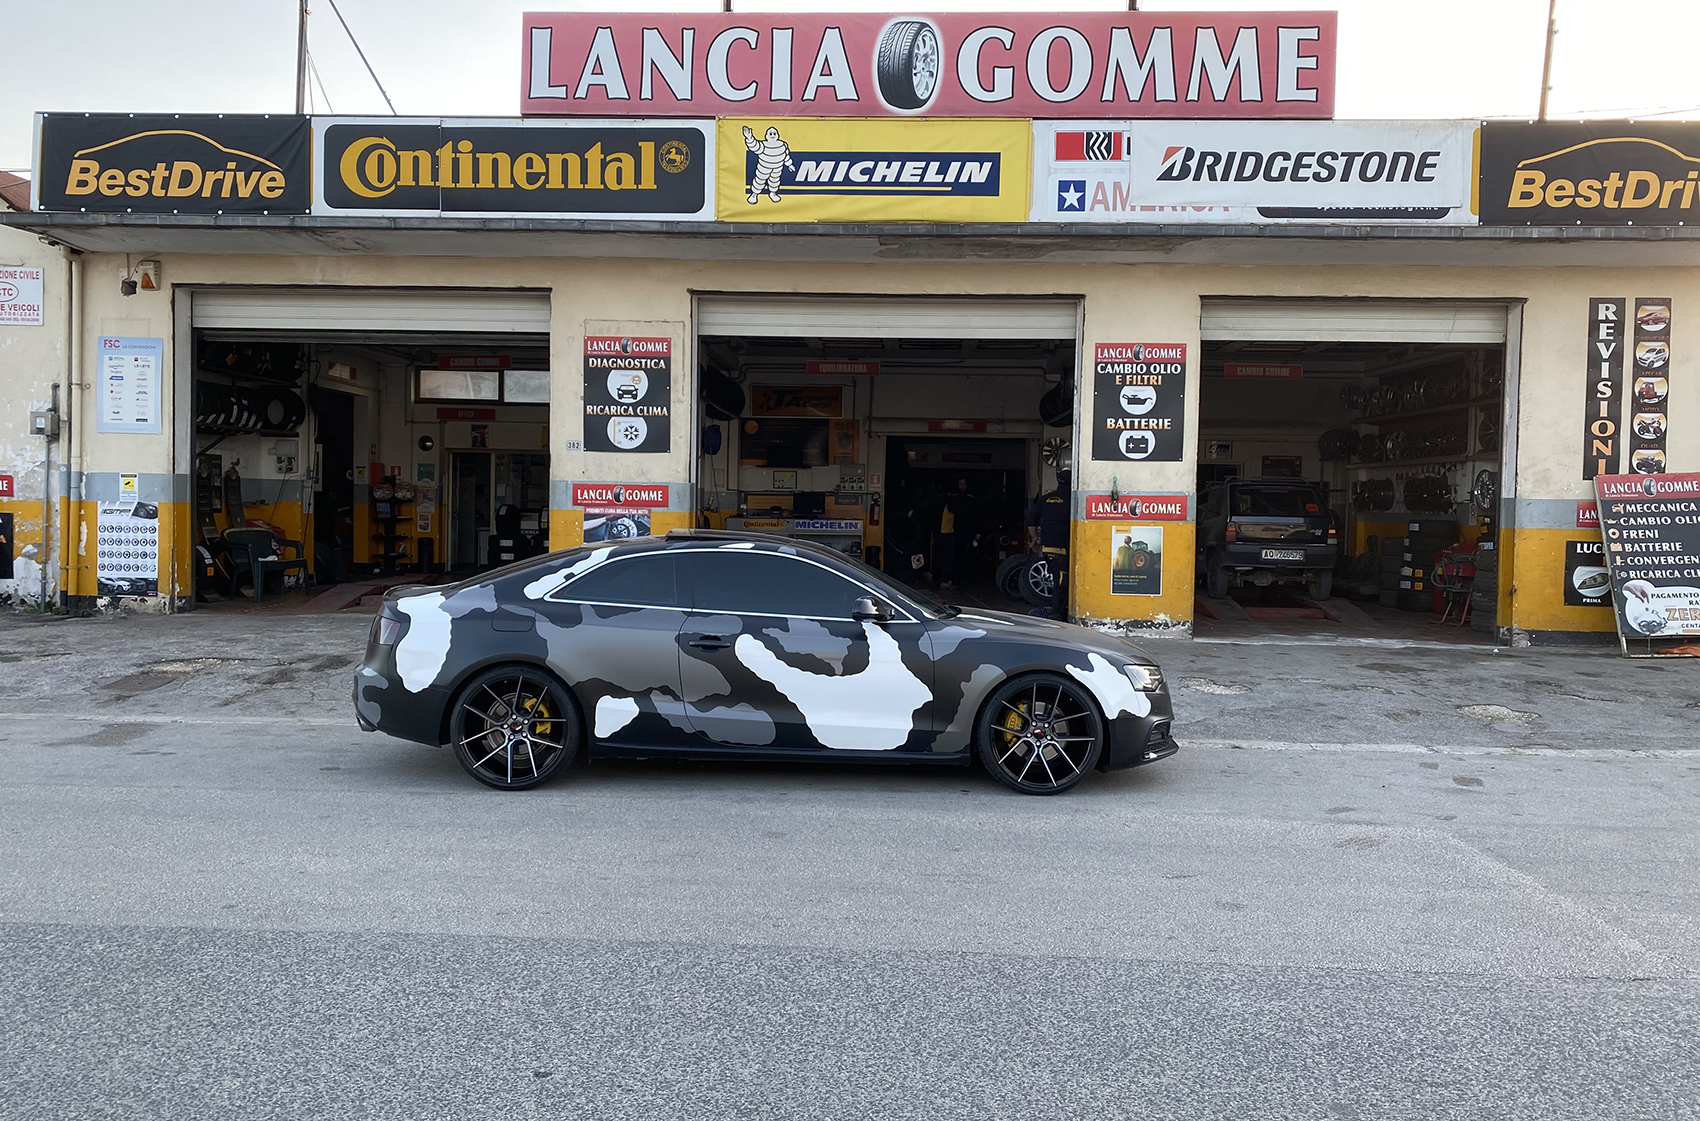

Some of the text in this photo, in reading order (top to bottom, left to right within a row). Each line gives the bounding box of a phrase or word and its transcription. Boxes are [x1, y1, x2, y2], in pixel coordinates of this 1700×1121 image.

[529, 25, 1320, 103] LANCIA GOMME
[339, 136, 657, 198] Continental
[1155, 145, 1441, 184] BRIDGESTONE
[795, 159, 992, 185] MICHELIN
[65, 160, 286, 199] BestDrive
[1507, 169, 1700, 209] BestDri
[19, 271, 39, 280] CIVILE
[0, 288, 13, 296] TC
[103, 339, 120, 348] FSC
[587, 341, 668, 352] LANCIA GOMME
[1098, 348, 1182, 359] LANCIA GOMME
[588, 358, 666, 369] DIAGNOSTICA
[819, 363, 868, 373] EQUILIBRATURA
[1097, 363, 1182, 374] CAMBIO OLIO
[1237, 366, 1290, 377] CAMBIO GOMME
[1115, 375, 1162, 385] E FILTRI
[1591, 303, 1618, 475] REVISIONI
[586, 404, 669, 417] RICARICA CLIMA
[1106, 418, 1171, 430] BATTERIE
[1604, 480, 1699, 494] LANCIA GOMME
[577, 489, 663, 502] LANCIA GOMME
[1091, 502, 1181, 514] LANCIA GOMME
[1626, 502, 1698, 513] MECCANICA
[743, 520, 859, 530] Continental MICHELIN
[1620, 517, 1672, 526] CAMBIO
[1622, 529, 1659, 540] FRENI
[1624, 542, 1683, 552] BATTERIE
[1627, 555, 1700, 566] CONVERGEN
[1629, 569, 1681, 580] RICARICA
